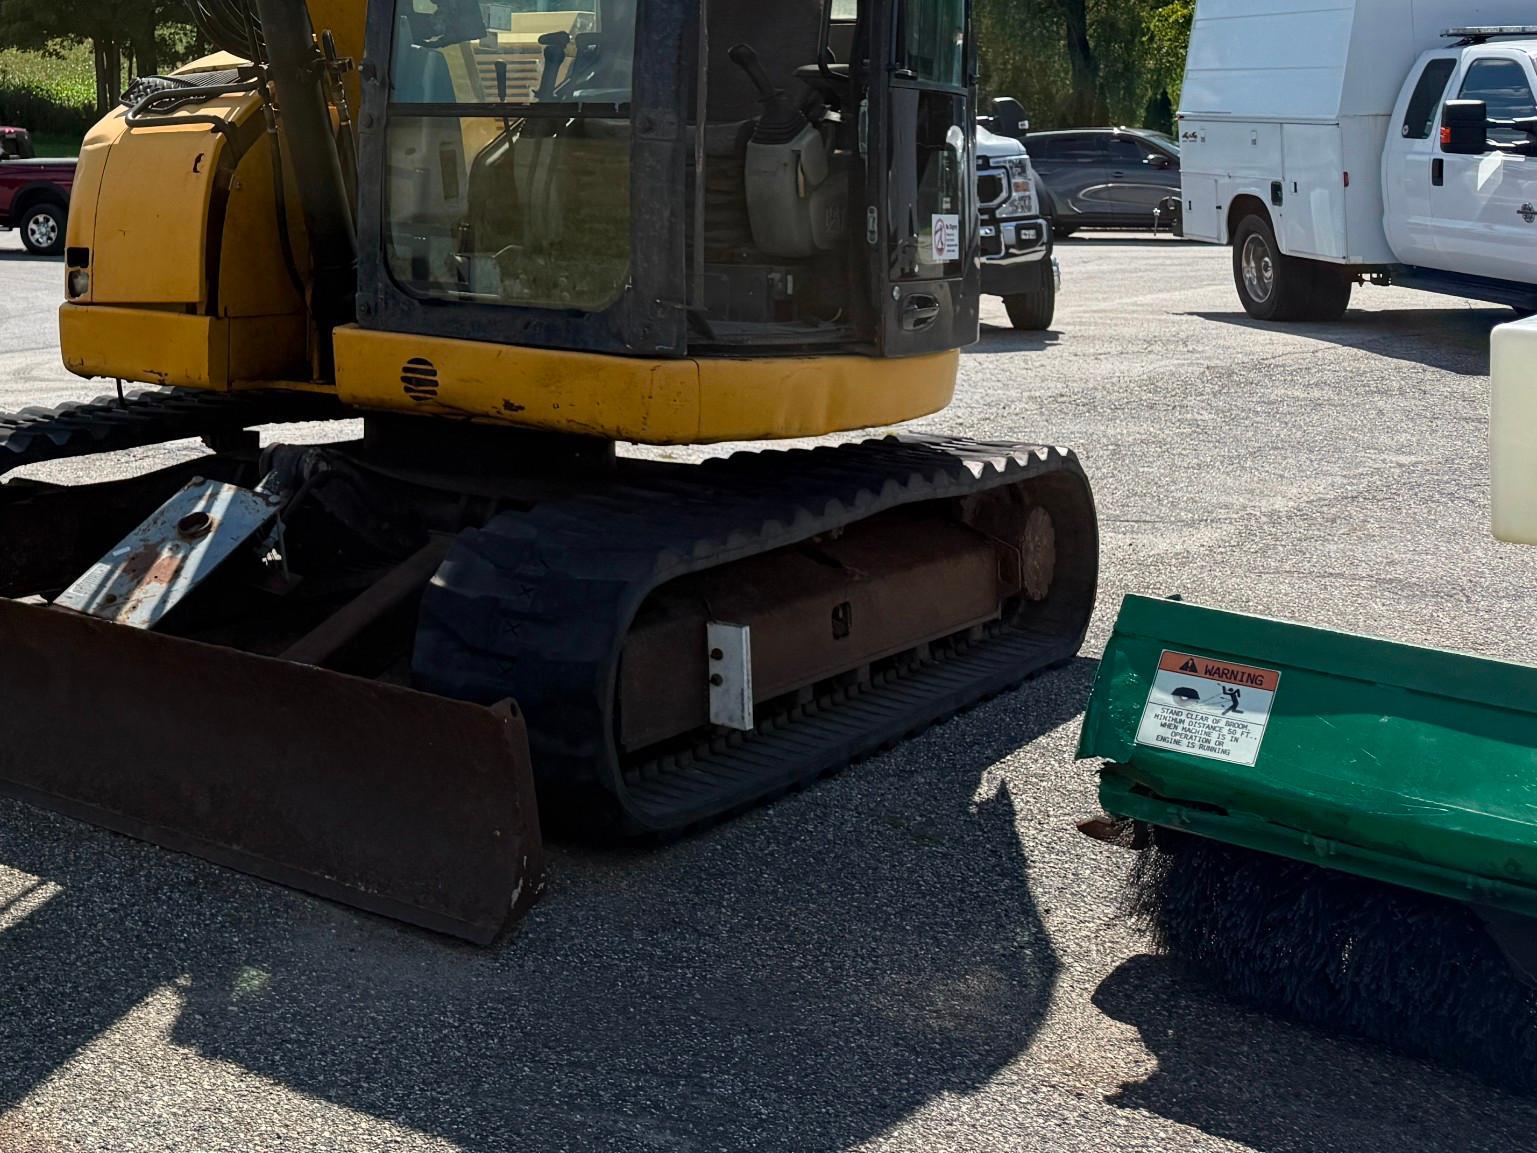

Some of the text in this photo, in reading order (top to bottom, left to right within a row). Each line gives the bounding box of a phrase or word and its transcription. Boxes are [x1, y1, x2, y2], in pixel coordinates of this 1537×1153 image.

[1204, 664, 1264, 686] WARNING
[1154, 713, 1185, 725] MINIMUM
[1188, 720, 1224, 733] DISTANCE
[1161, 707, 1183, 717] STAND
[1186, 712, 1209, 722] CLEAR
[1212, 715, 1222, 724] OF
[1160, 721, 1179, 730] WHEN
[1181, 726, 1213, 737] MACHINE
[1230, 735, 1239, 743] IN
[1170, 730, 1224, 747] OPERATION OR
[1155, 734, 1183, 745] ENGINE
[1199, 744, 1231, 756] RUNNING
